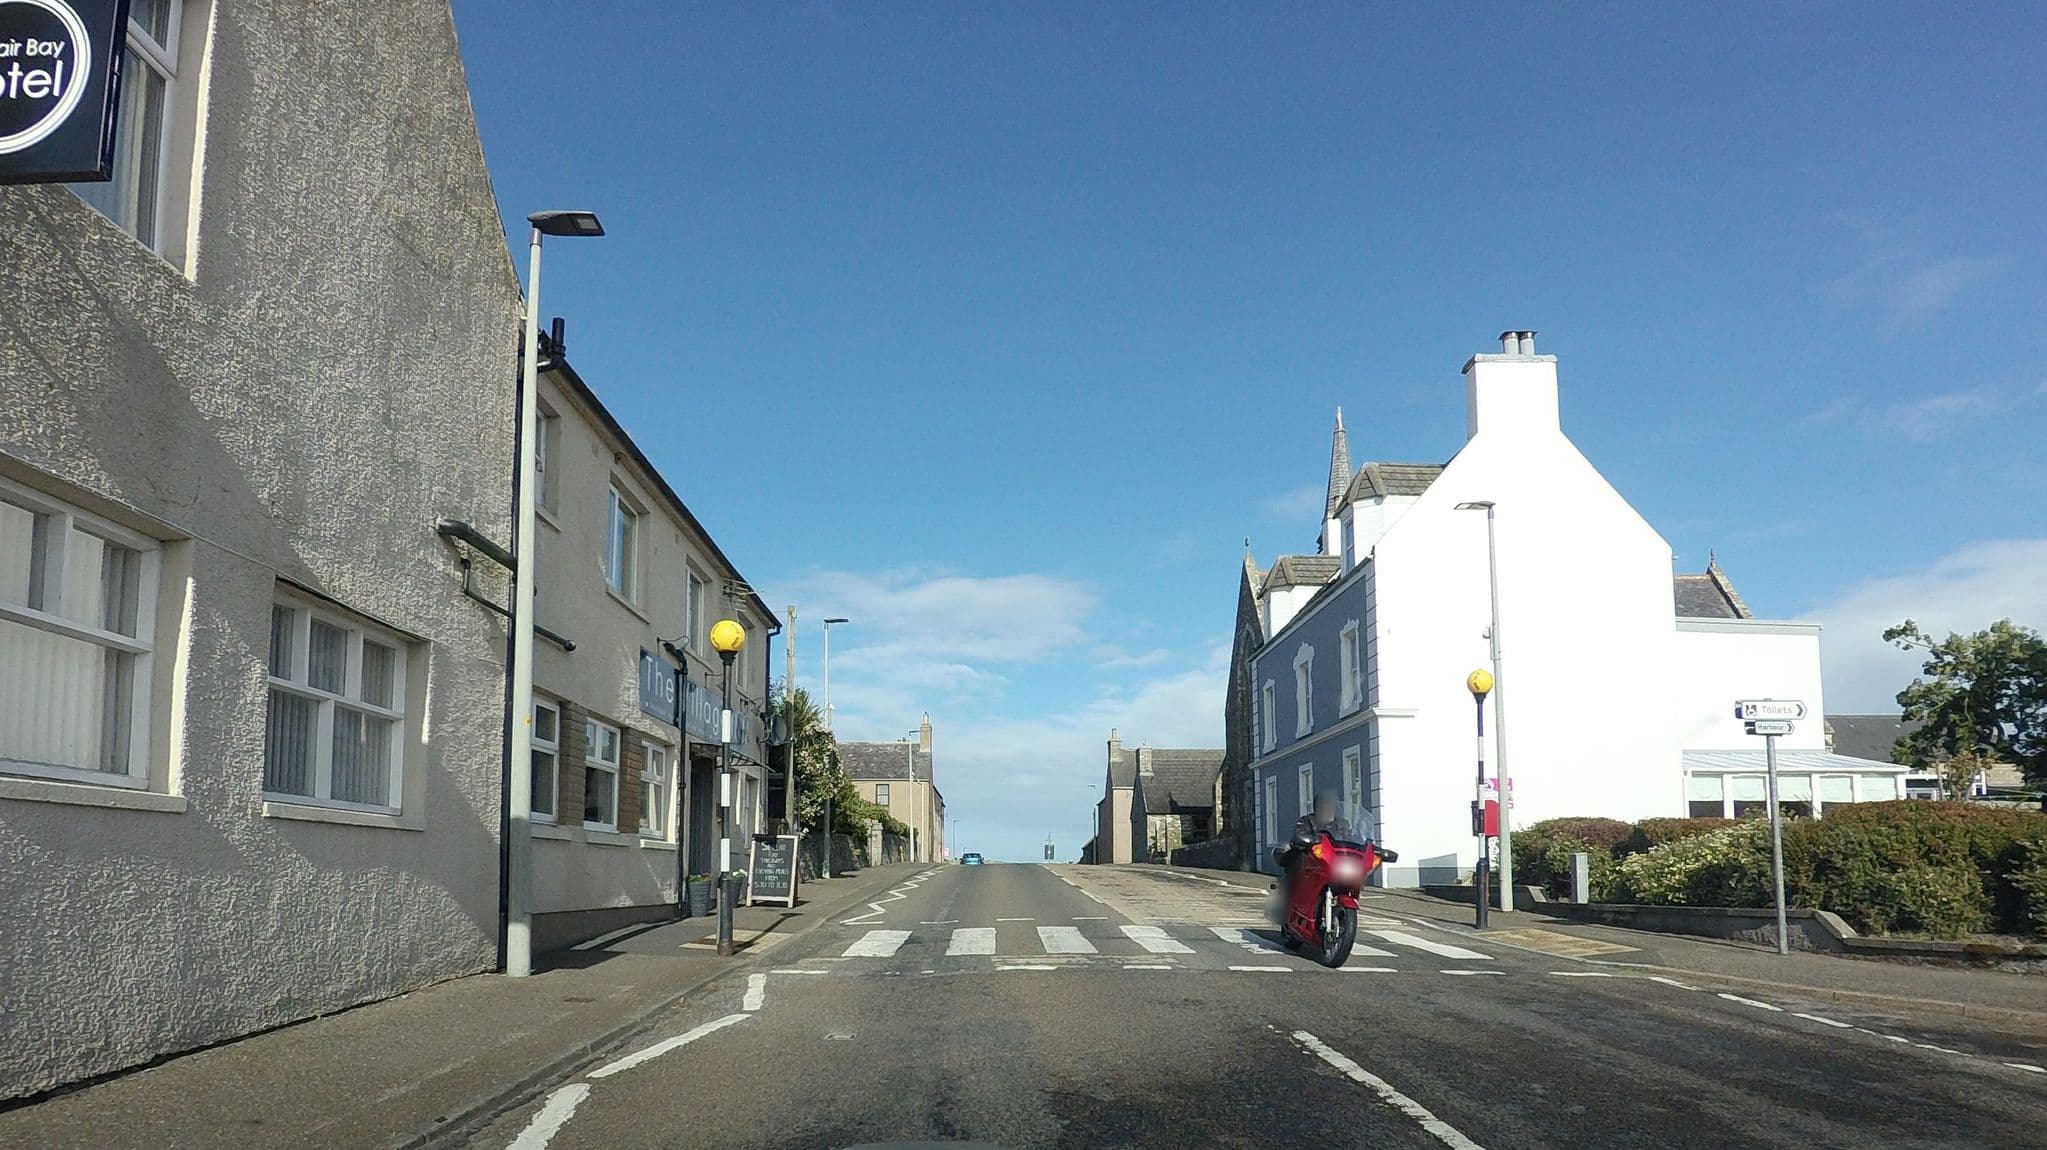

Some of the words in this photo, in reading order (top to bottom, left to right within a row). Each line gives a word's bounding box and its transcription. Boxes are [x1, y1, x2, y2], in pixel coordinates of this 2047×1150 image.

[26, 38, 65, 58] Bay
[0, 60, 64, 99] tel
[645, 655, 674, 704] The
[686, 682, 720, 736] illag
[1761, 705, 1792, 714] Toilets
[1757, 723, 1785, 731] Harbour
